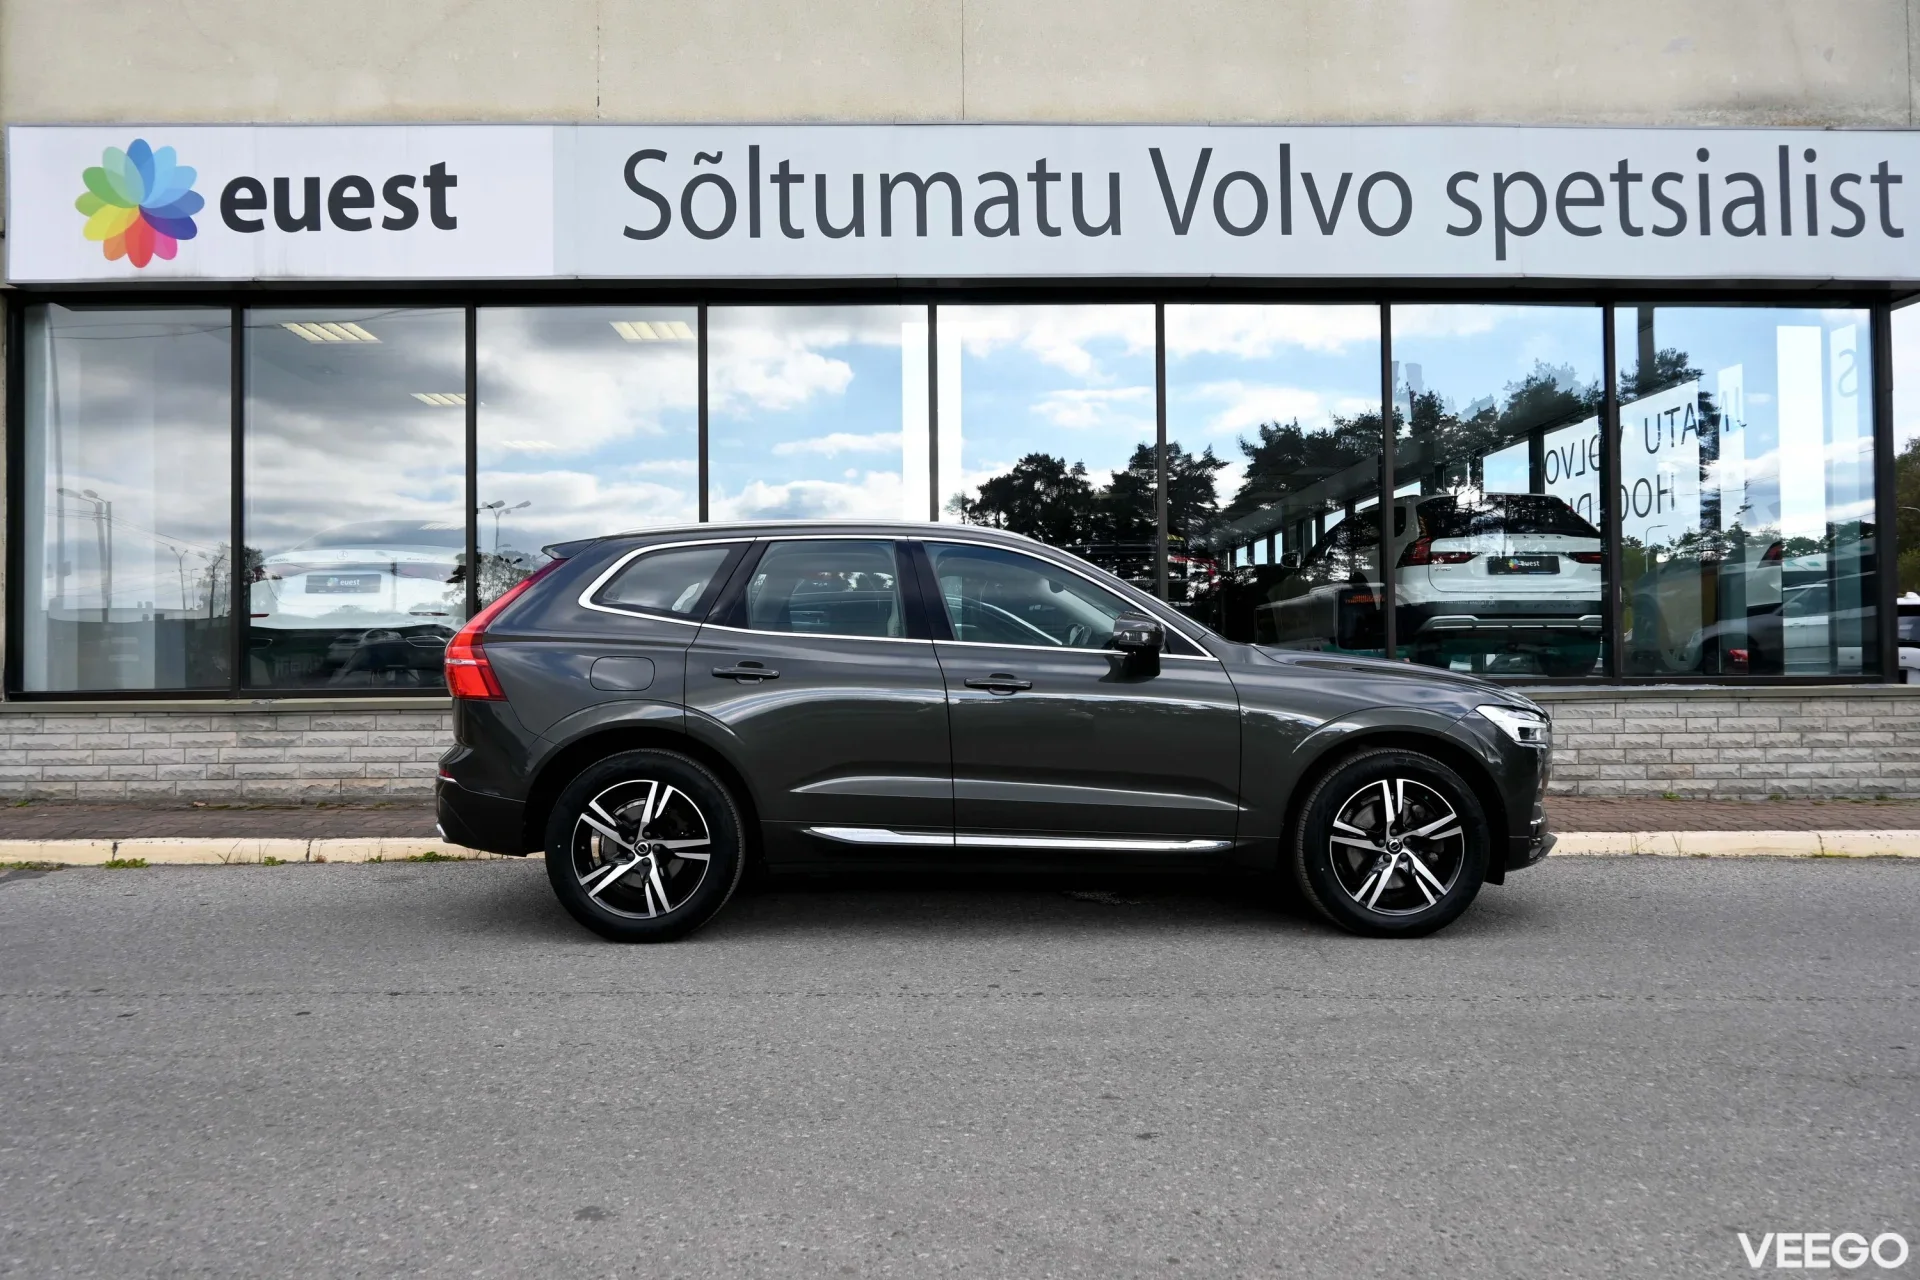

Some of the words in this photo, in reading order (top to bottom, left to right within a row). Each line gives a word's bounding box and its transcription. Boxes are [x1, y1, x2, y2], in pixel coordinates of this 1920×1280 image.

[220, 162, 457, 233] euest
[624, 145, 1121, 240] Sõltumatu
[1149, 144, 1412, 236] Volvo
[1447, 145, 1904, 260] spetsialist
